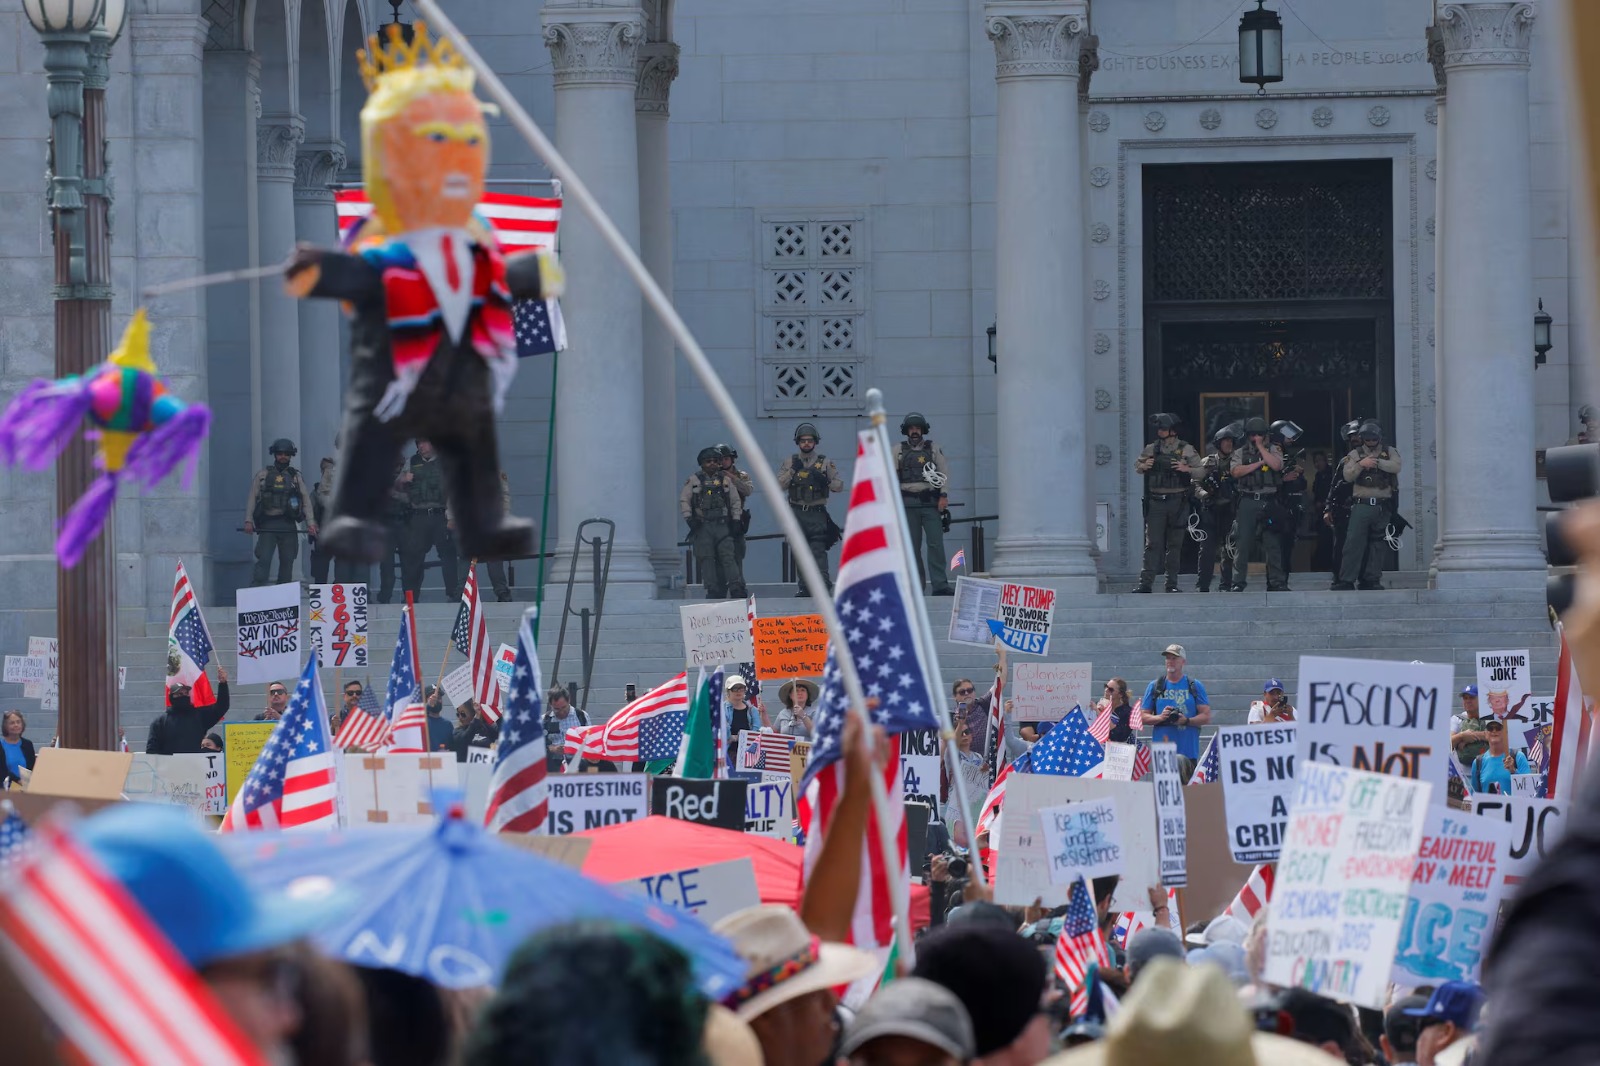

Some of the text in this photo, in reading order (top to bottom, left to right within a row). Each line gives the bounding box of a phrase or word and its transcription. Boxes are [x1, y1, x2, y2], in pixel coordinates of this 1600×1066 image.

[1102, 55, 1206, 72] GHTEOUSNESS
[1379, 52, 1425, 65] SOLOM
[309, 588, 321, 609] NO
[352, 586, 368, 633] KINGS
[1001, 606, 1049, 623] YOU SWORE
[1004, 616, 1050, 634] TO PROTECT
[239, 623, 279, 642] SAY NO
[1002, 628, 1043, 653] THIS
[259, 635, 297, 657] KINGS
[355, 647, 367, 667] NO
[760, 648, 773, 657] TO
[805, 643, 825, 652] FREE
[1016, 663, 1088, 681] Colonizers
[1481, 655, 1525, 668] FAUX-KING
[1490, 667, 1517, 681] JOKE
[1309, 681, 1438, 730] FASCISM
[1221, 728, 1297, 749] PROTEST
[1153, 750, 1167, 774] ICE
[1230, 758, 1257, 784] IS
[1309, 741, 1431, 780] IS NOT
[665, 781, 720, 821] Red
[1158, 781, 1169, 806] OF
[1271, 795, 1288, 817] A
[547, 808, 638, 835] IS NOT
[1053, 806, 1115, 831] ice melts
[1064, 829, 1099, 848] under
[1235, 821, 1287, 848] CRI
[1053, 844, 1120, 871] resistance
[1418, 836, 1497, 864] EAUTIFUL
[1412, 861, 1437, 885] AY
[1448, 864, 1497, 889] MELT
[1398, 897, 1489, 972] ICE
